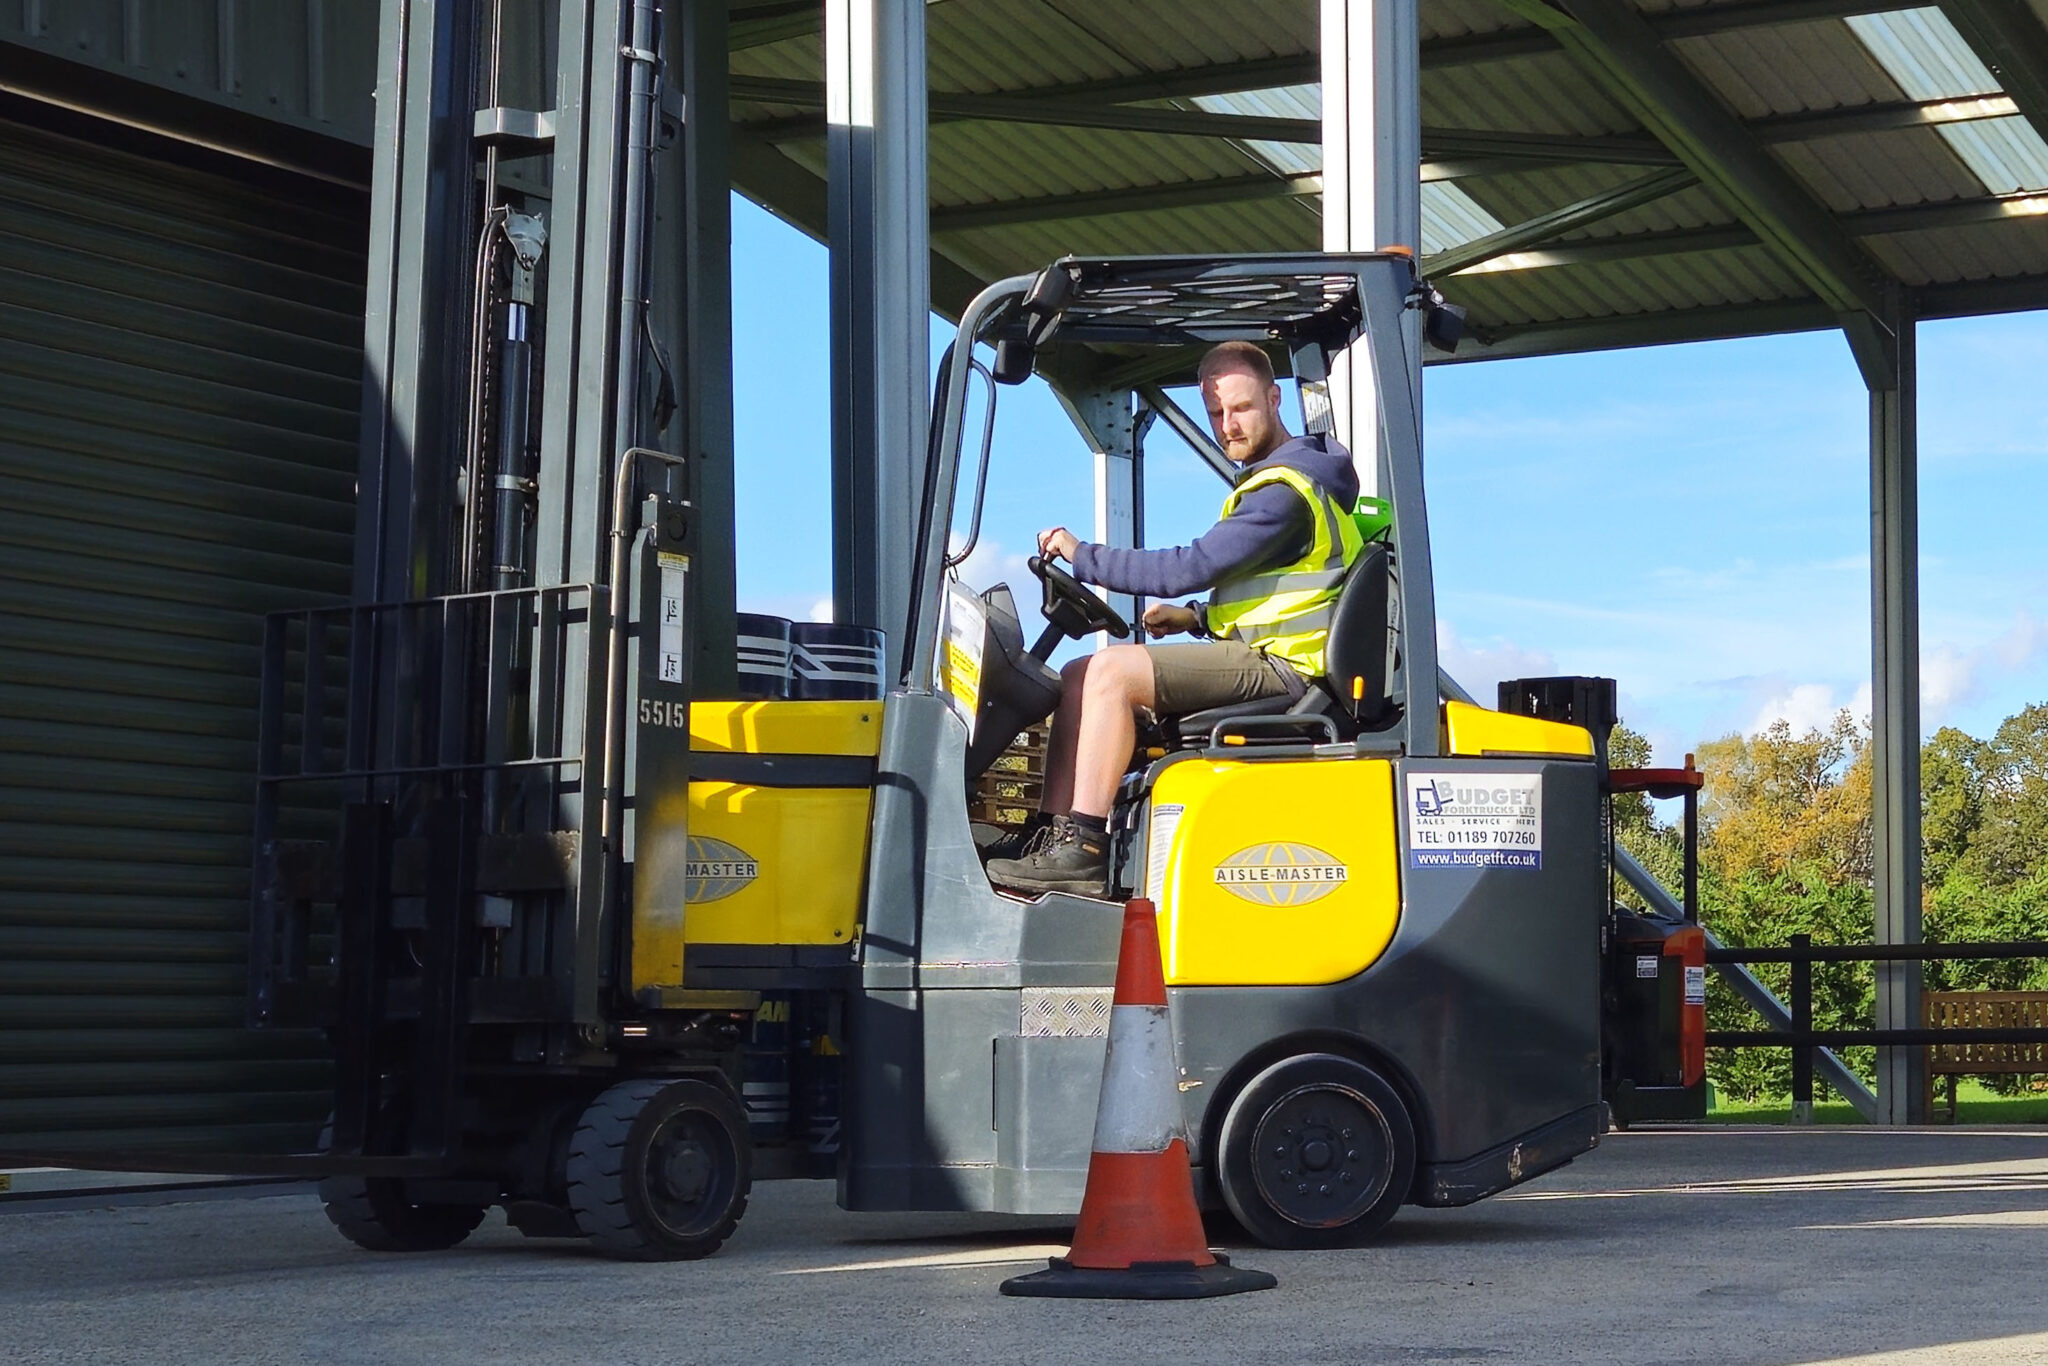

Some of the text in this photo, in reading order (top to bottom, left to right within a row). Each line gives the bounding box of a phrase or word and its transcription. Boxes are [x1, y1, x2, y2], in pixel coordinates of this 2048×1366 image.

[640, 699, 683, 729] 5515
[1437, 781, 1534, 806] BUDGET
[1443, 806, 1535, 815] FORKTRUCKS LTD
[1417, 831, 1535, 844] TEL: 01189 707260
[1418, 851, 1536, 867] www.budgetft.co.uk
[1216, 867, 1346, 881] AISLE-MASTER
